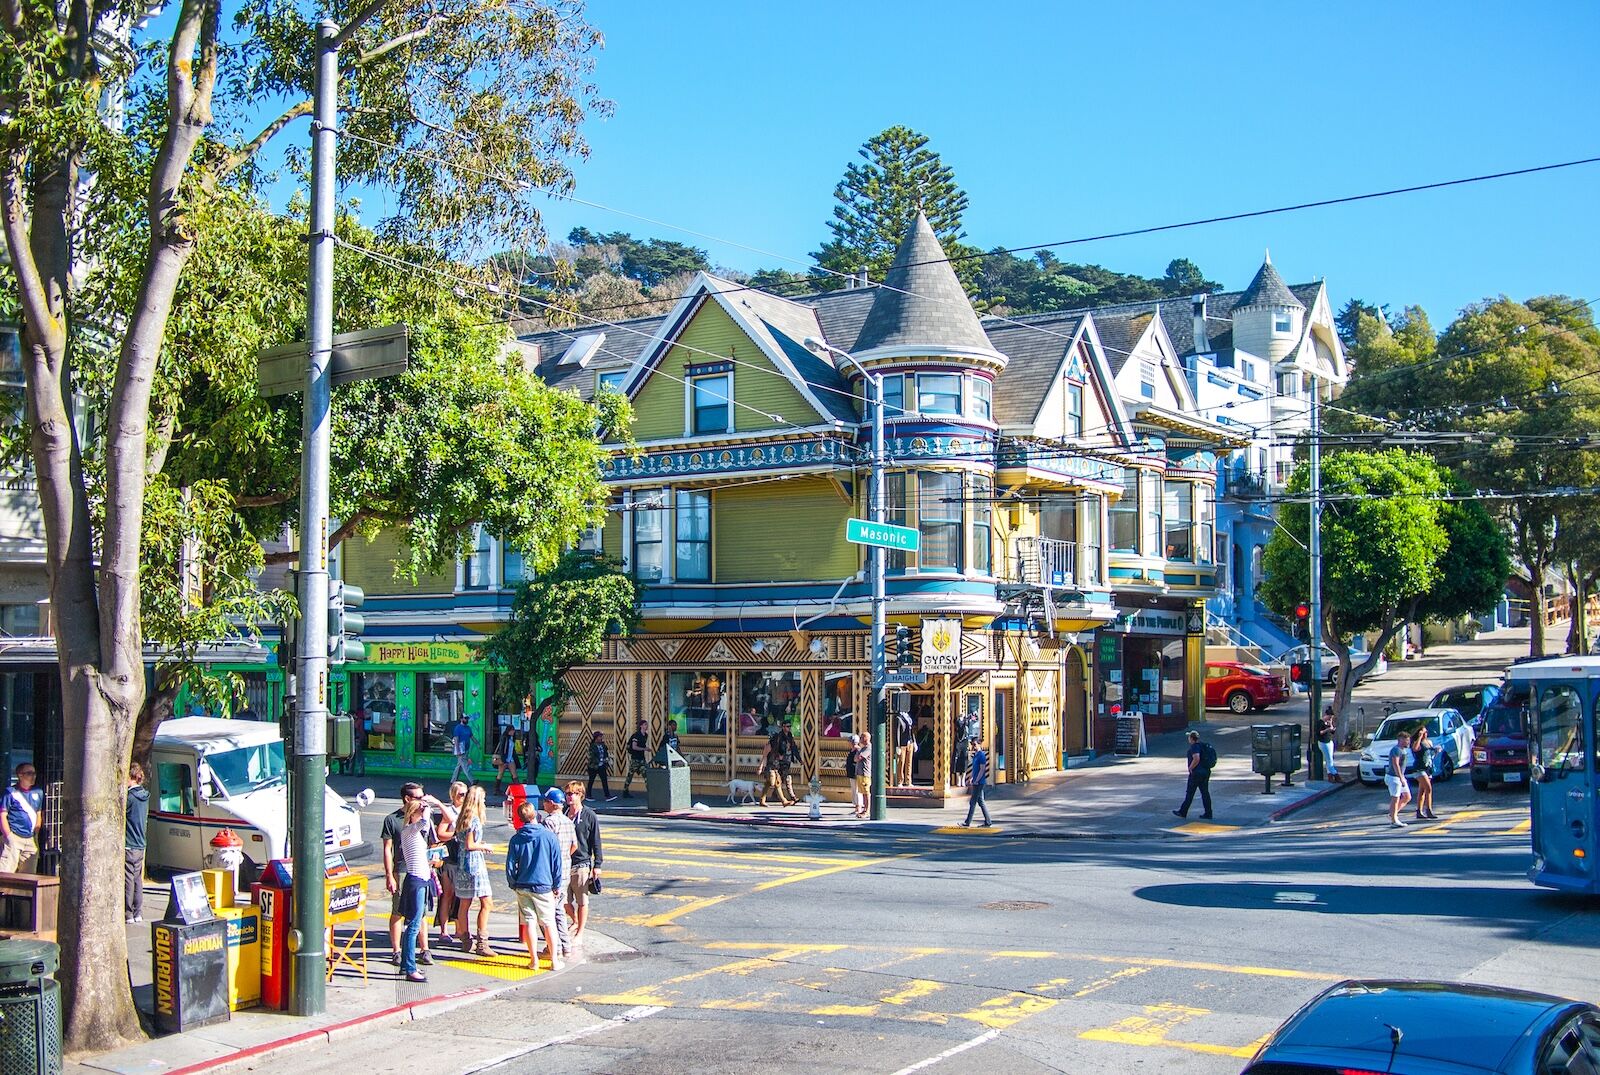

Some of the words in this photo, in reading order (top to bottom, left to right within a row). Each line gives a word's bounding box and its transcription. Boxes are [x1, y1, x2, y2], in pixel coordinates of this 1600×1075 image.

[860, 526, 907, 544] Masonic
[924, 655, 958, 665] GYPSY
[261, 891, 273, 914] SF
[183, 935, 223, 955] GUARDIAN
[155, 927, 173, 1015] GUARDIAN
